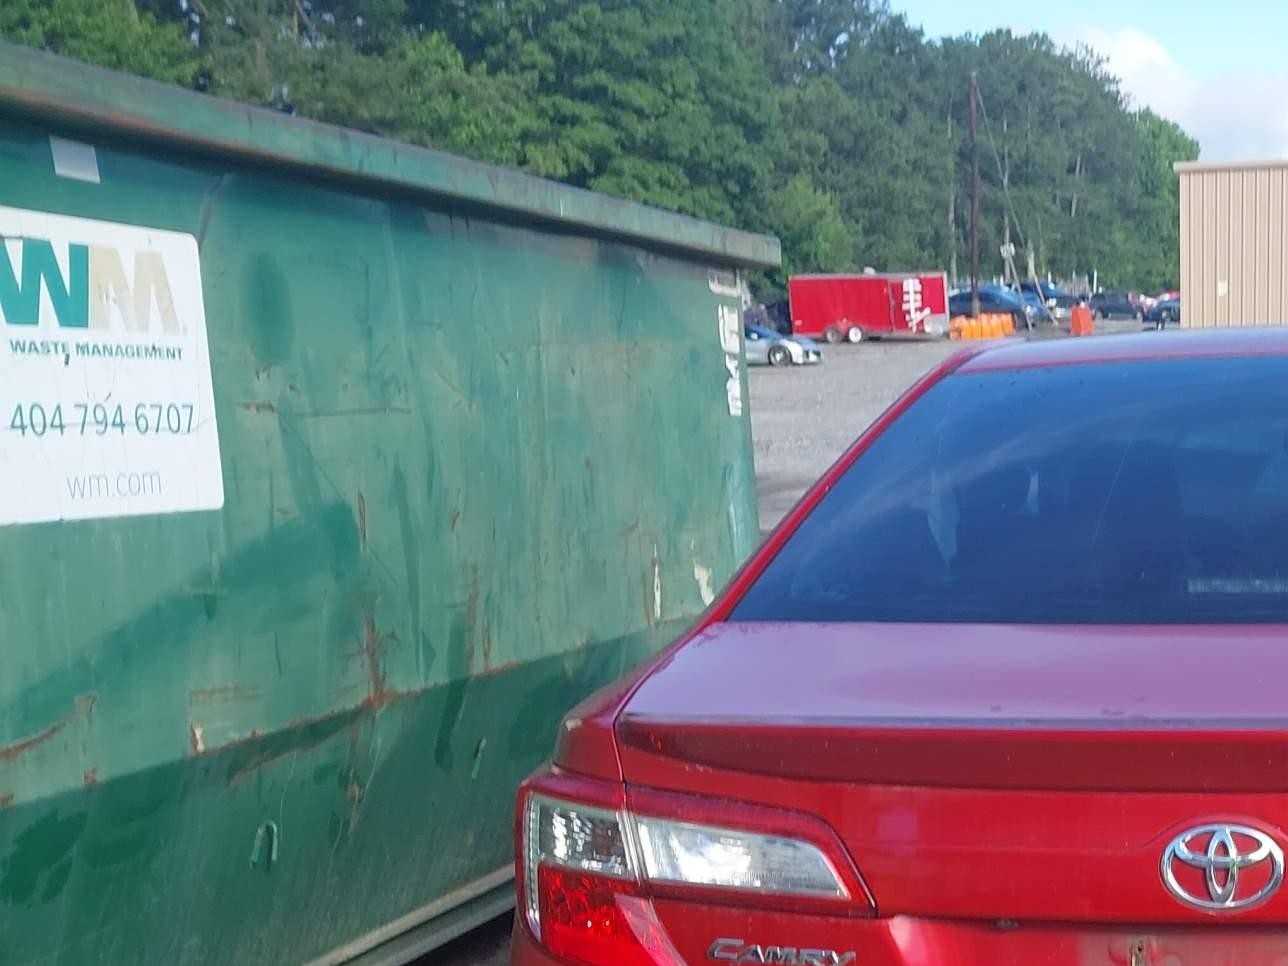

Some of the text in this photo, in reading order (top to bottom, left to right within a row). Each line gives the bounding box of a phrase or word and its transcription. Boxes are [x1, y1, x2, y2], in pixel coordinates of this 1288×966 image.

[0, 236, 180, 335] WM
[9, 339, 183, 361] WASTE MANAGEMENT
[10, 402, 194, 437] 404 794 6707
[66, 471, 162, 500] wm.com
